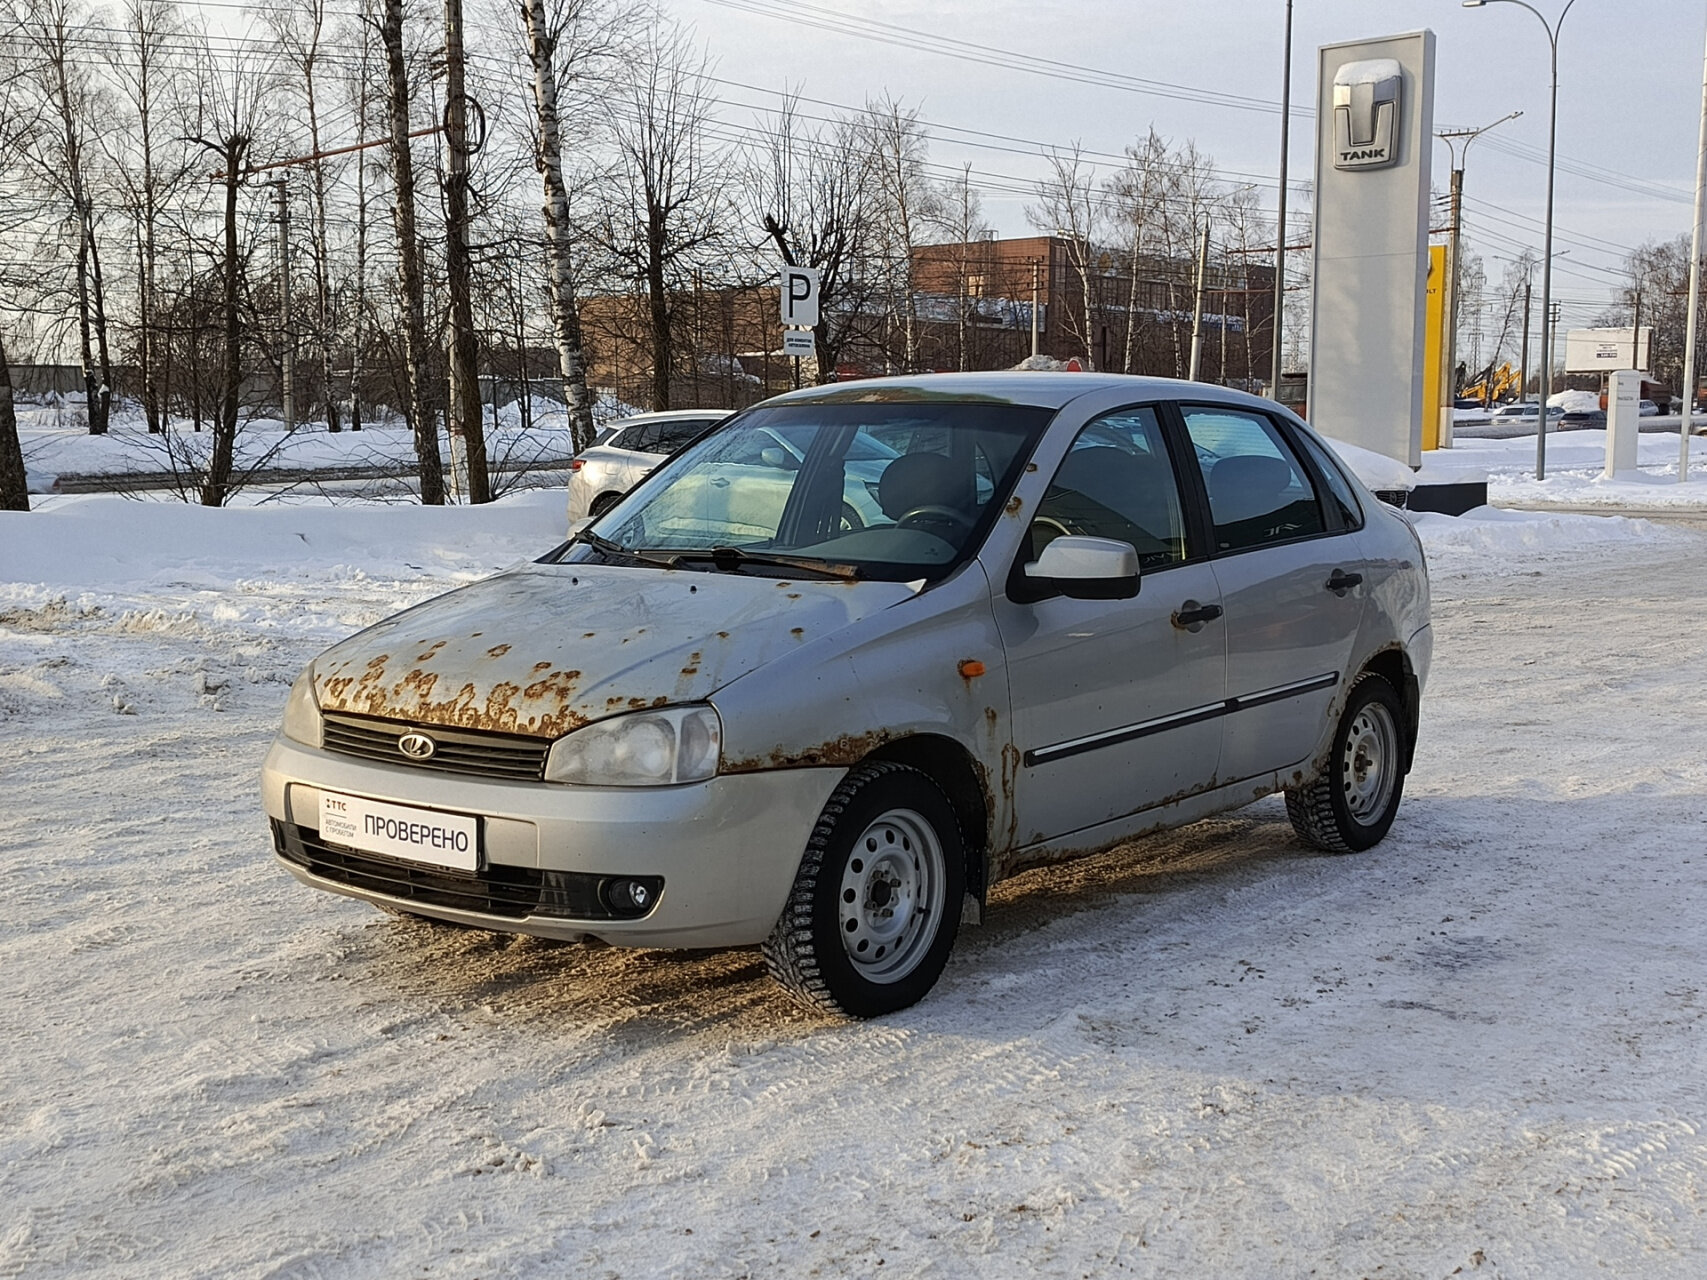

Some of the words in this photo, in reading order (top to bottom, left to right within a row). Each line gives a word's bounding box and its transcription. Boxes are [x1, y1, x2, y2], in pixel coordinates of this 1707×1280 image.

[1340, 148, 1385, 161] TANK
[788, 273, 811, 318] P
[364, 814, 469, 852] ПРОВЕРЕНО
